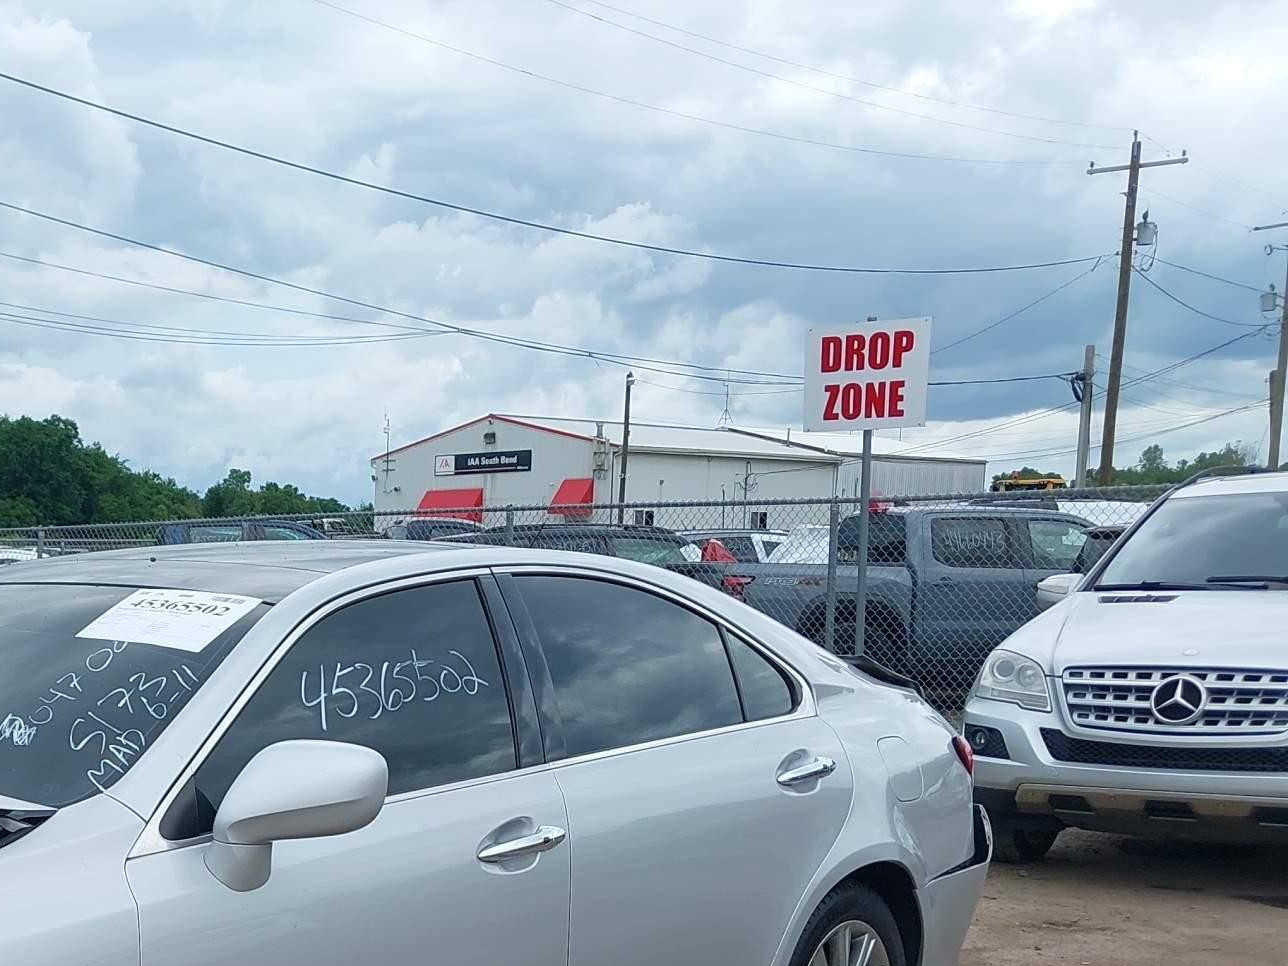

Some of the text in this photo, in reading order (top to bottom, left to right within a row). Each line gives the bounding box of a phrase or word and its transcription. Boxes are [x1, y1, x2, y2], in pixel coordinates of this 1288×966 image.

[820, 331, 914, 373] DROP
[823, 380, 905, 421] ZONE
[467, 455, 518, 466] IAA South Bend
[130, 597, 232, 617] 45365502
[300, 648, 489, 731] 45365502
